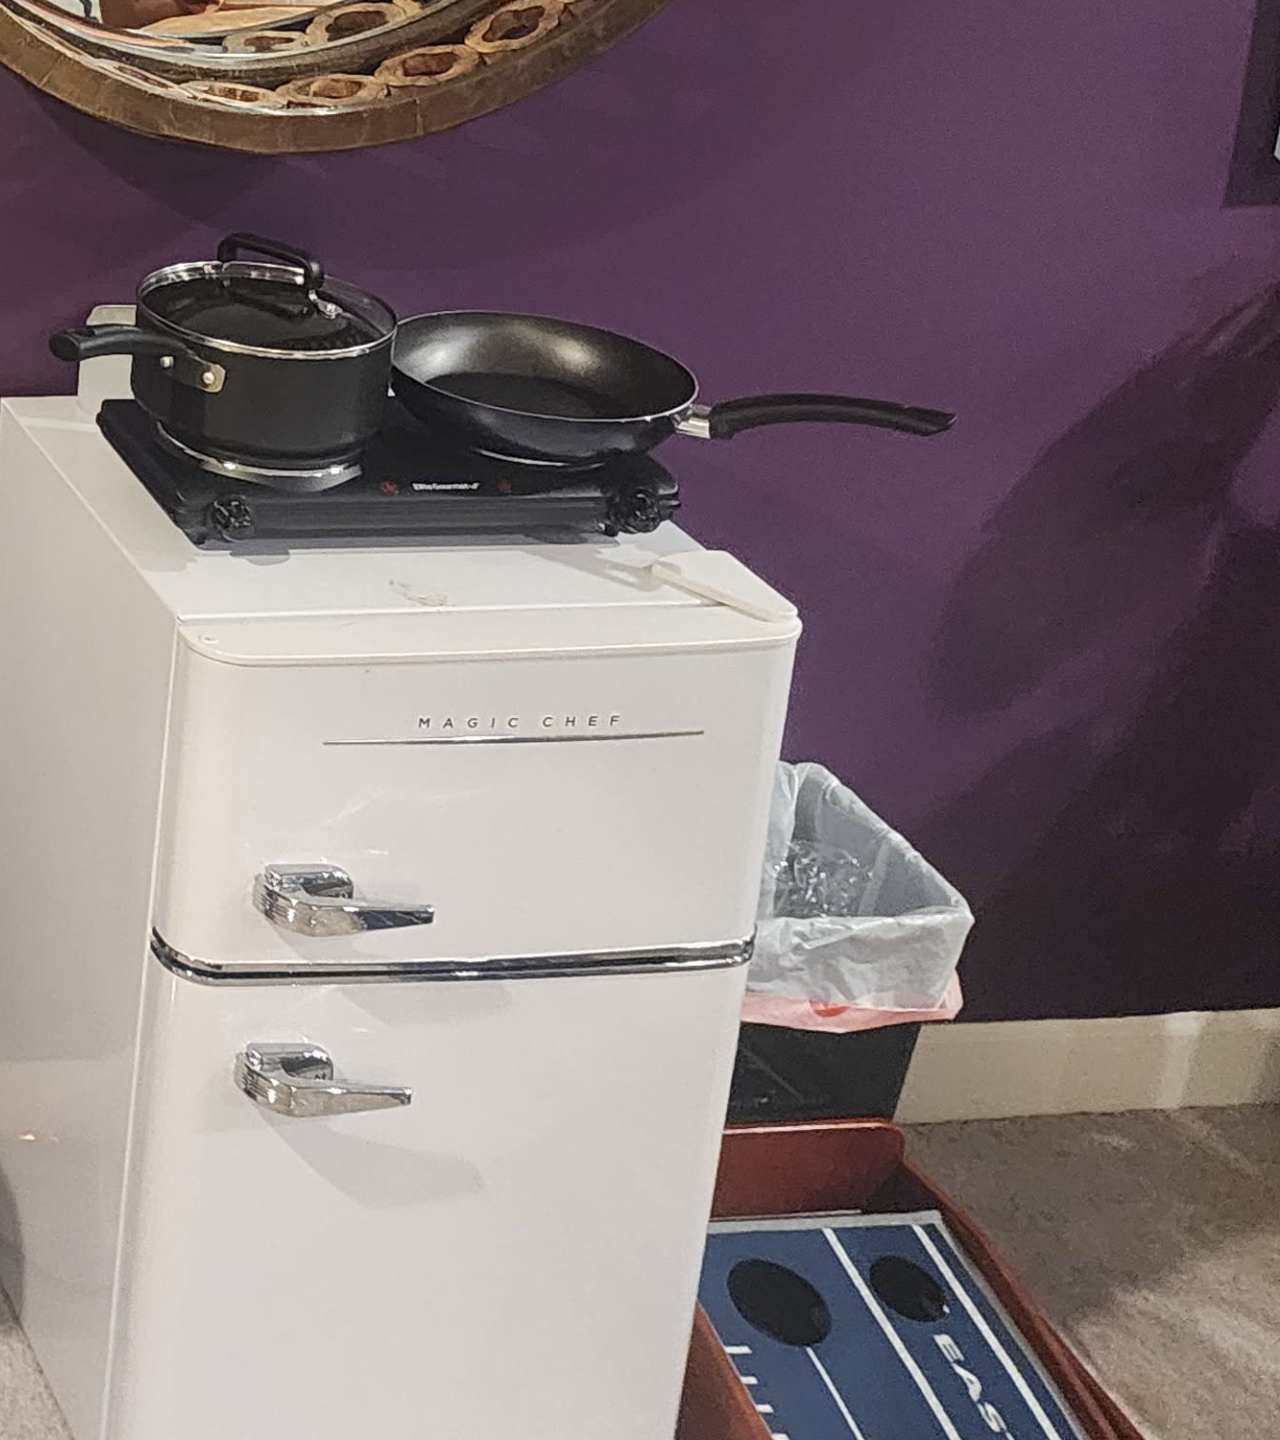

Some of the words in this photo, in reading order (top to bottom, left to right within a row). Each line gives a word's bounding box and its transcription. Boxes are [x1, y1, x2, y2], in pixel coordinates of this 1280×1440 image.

[418, 717, 520, 729] MAGIC
[542, 715, 621, 727] CHEF
[933, 1334, 1015, 1440] EAS
